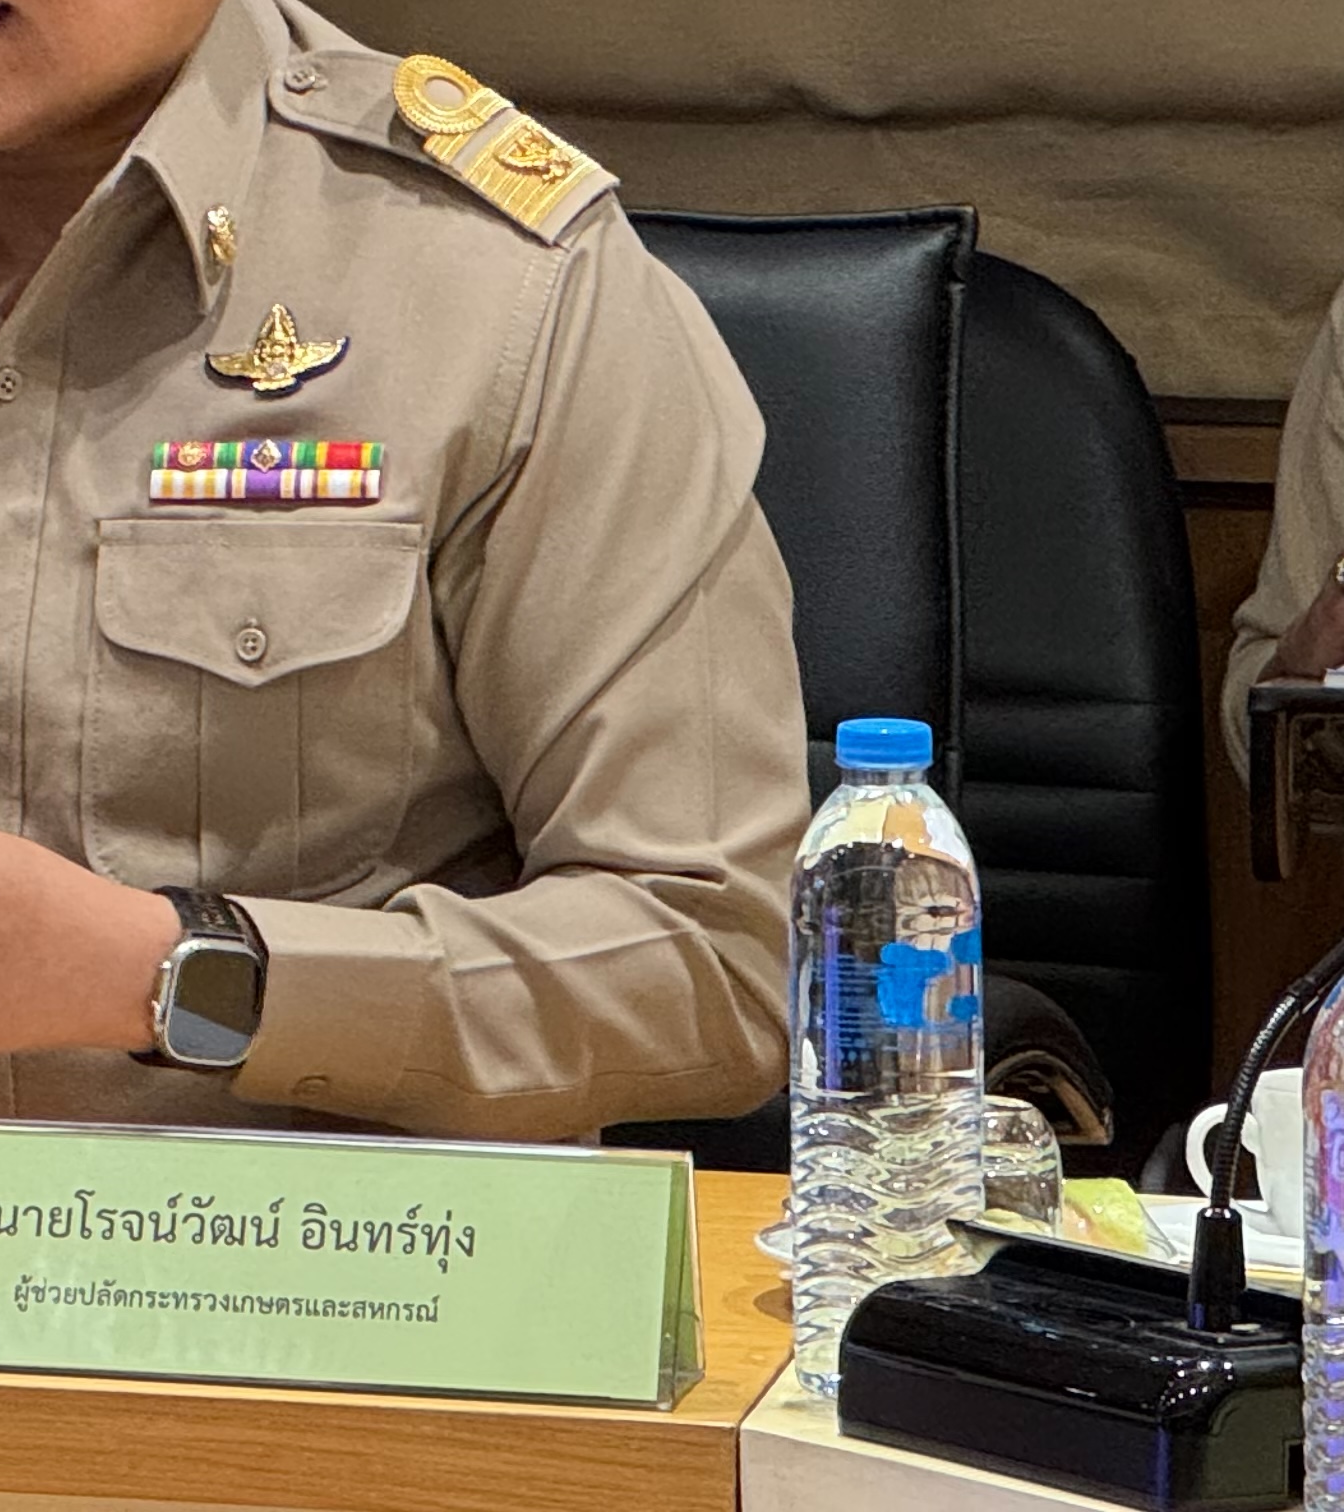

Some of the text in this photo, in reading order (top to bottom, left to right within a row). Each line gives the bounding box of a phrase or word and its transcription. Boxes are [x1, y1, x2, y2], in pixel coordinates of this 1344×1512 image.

[299, 1202, 477, 1274] อินทร์ทุ่ง
[13, 1274, 441, 1324] ผู้ช่วยปลัดกระทรวงเกษตรและสหกรณ์
